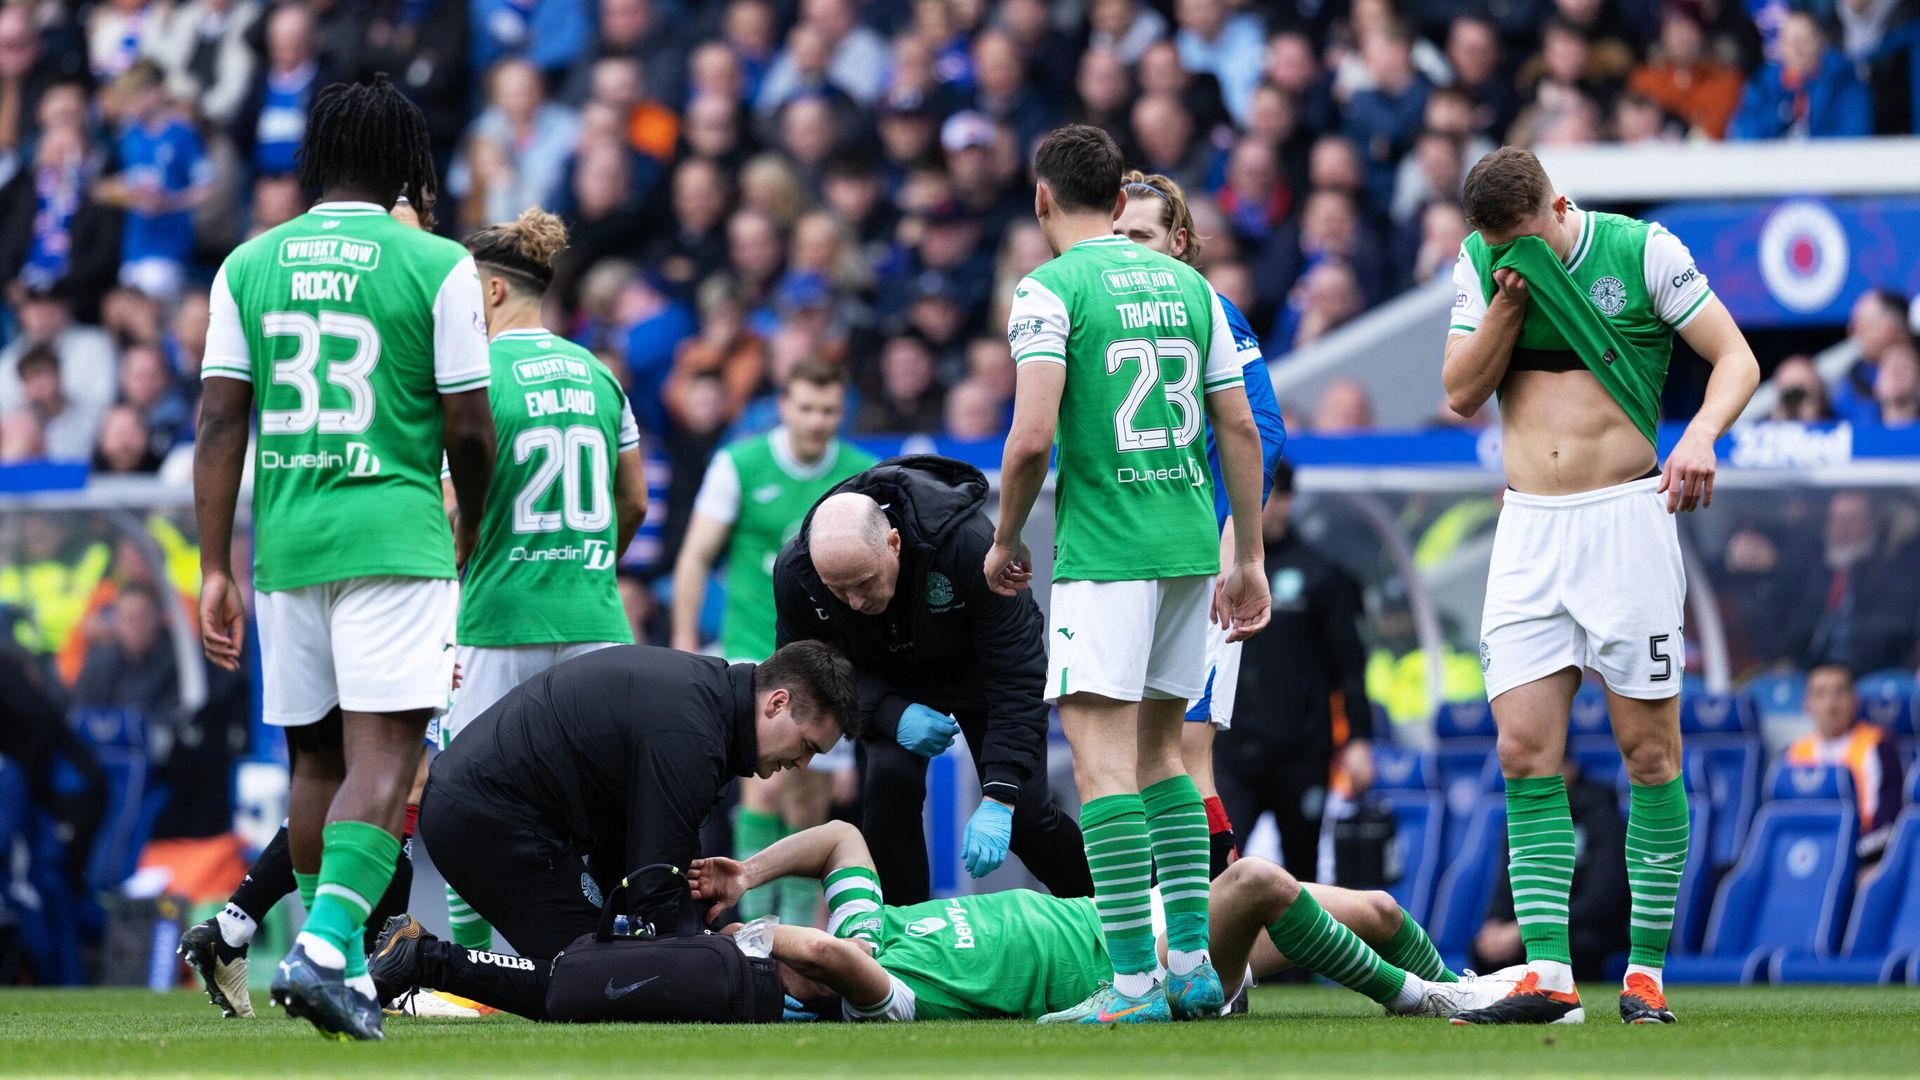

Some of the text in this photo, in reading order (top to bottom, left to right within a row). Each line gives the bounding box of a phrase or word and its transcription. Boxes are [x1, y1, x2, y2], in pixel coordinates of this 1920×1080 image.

[287, 240, 374, 263] WHISKY ROW
[291, 270, 359, 302] ROCKY
[1151, 272, 1176, 287] ROW
[260, 310, 381, 435] 33
[525, 388, 595, 418] EMILIANO
[1104, 336, 1202, 453] 23
[261, 450, 344, 469] Dunedin
[512, 424, 613, 535] 20
[1117, 463, 1188, 483] Dunedi
[508, 544, 583, 562] Dunedin
[1649, 634, 1671, 681] 5
[467, 949, 536, 971] Joma
